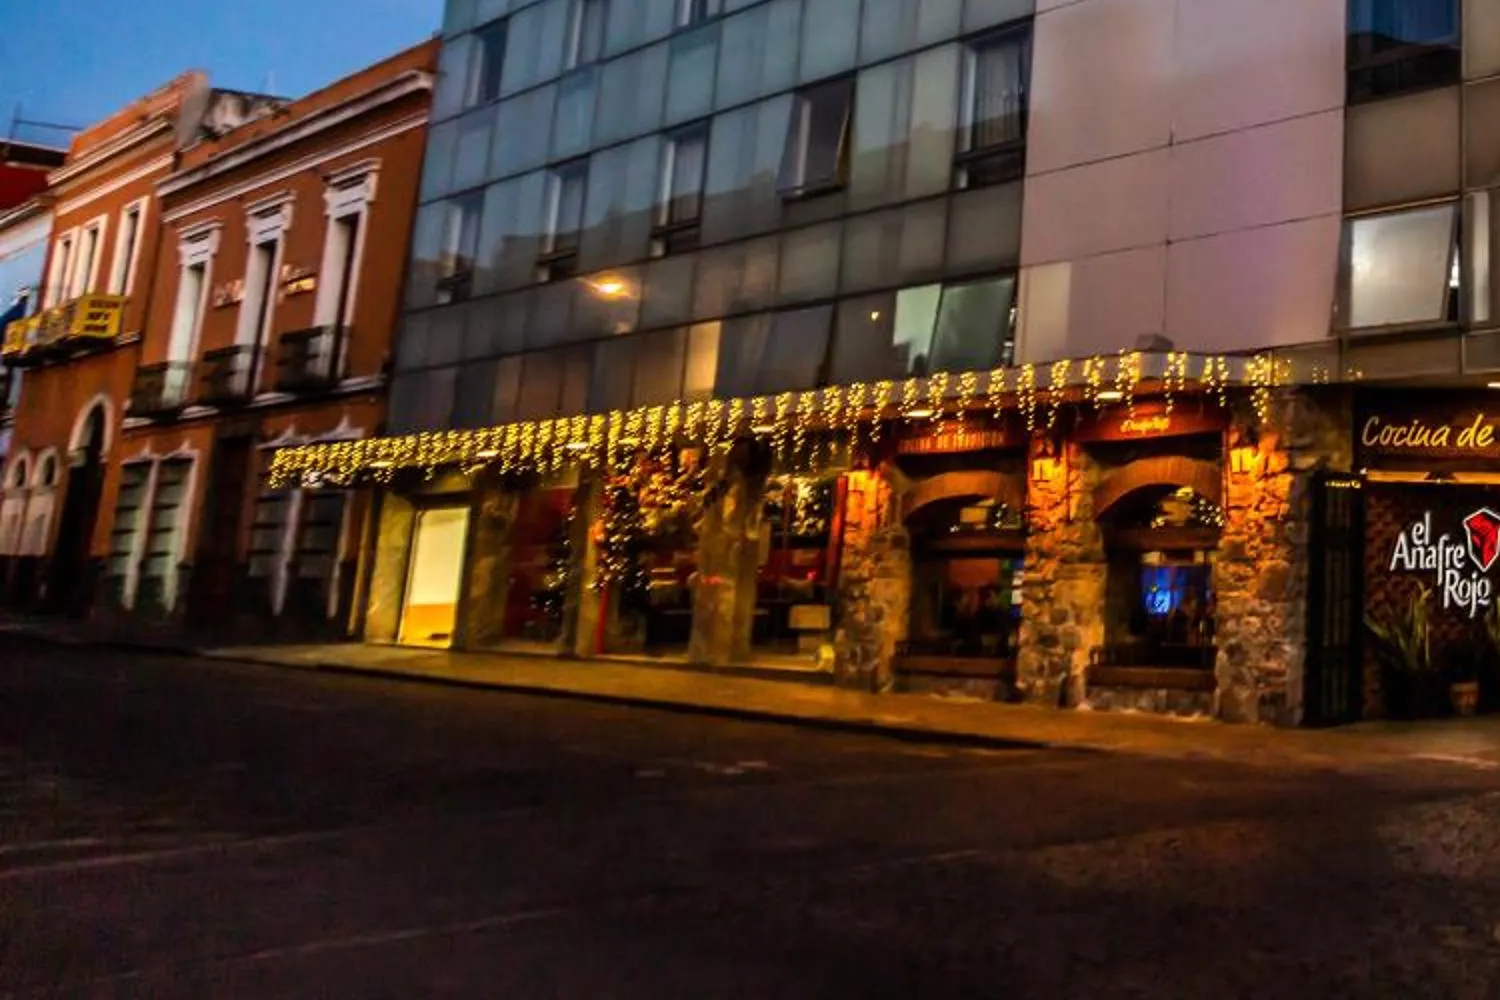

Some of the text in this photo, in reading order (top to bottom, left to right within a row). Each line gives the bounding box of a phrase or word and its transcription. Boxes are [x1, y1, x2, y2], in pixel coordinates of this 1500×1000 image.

[1361, 415, 1451, 448] Cocina
[1456, 413, 1494, 448] de
[1411, 510, 1431, 546] el
[1389, 532, 1466, 586] Anafre
[1443, 569, 1491, 618] Rojo
